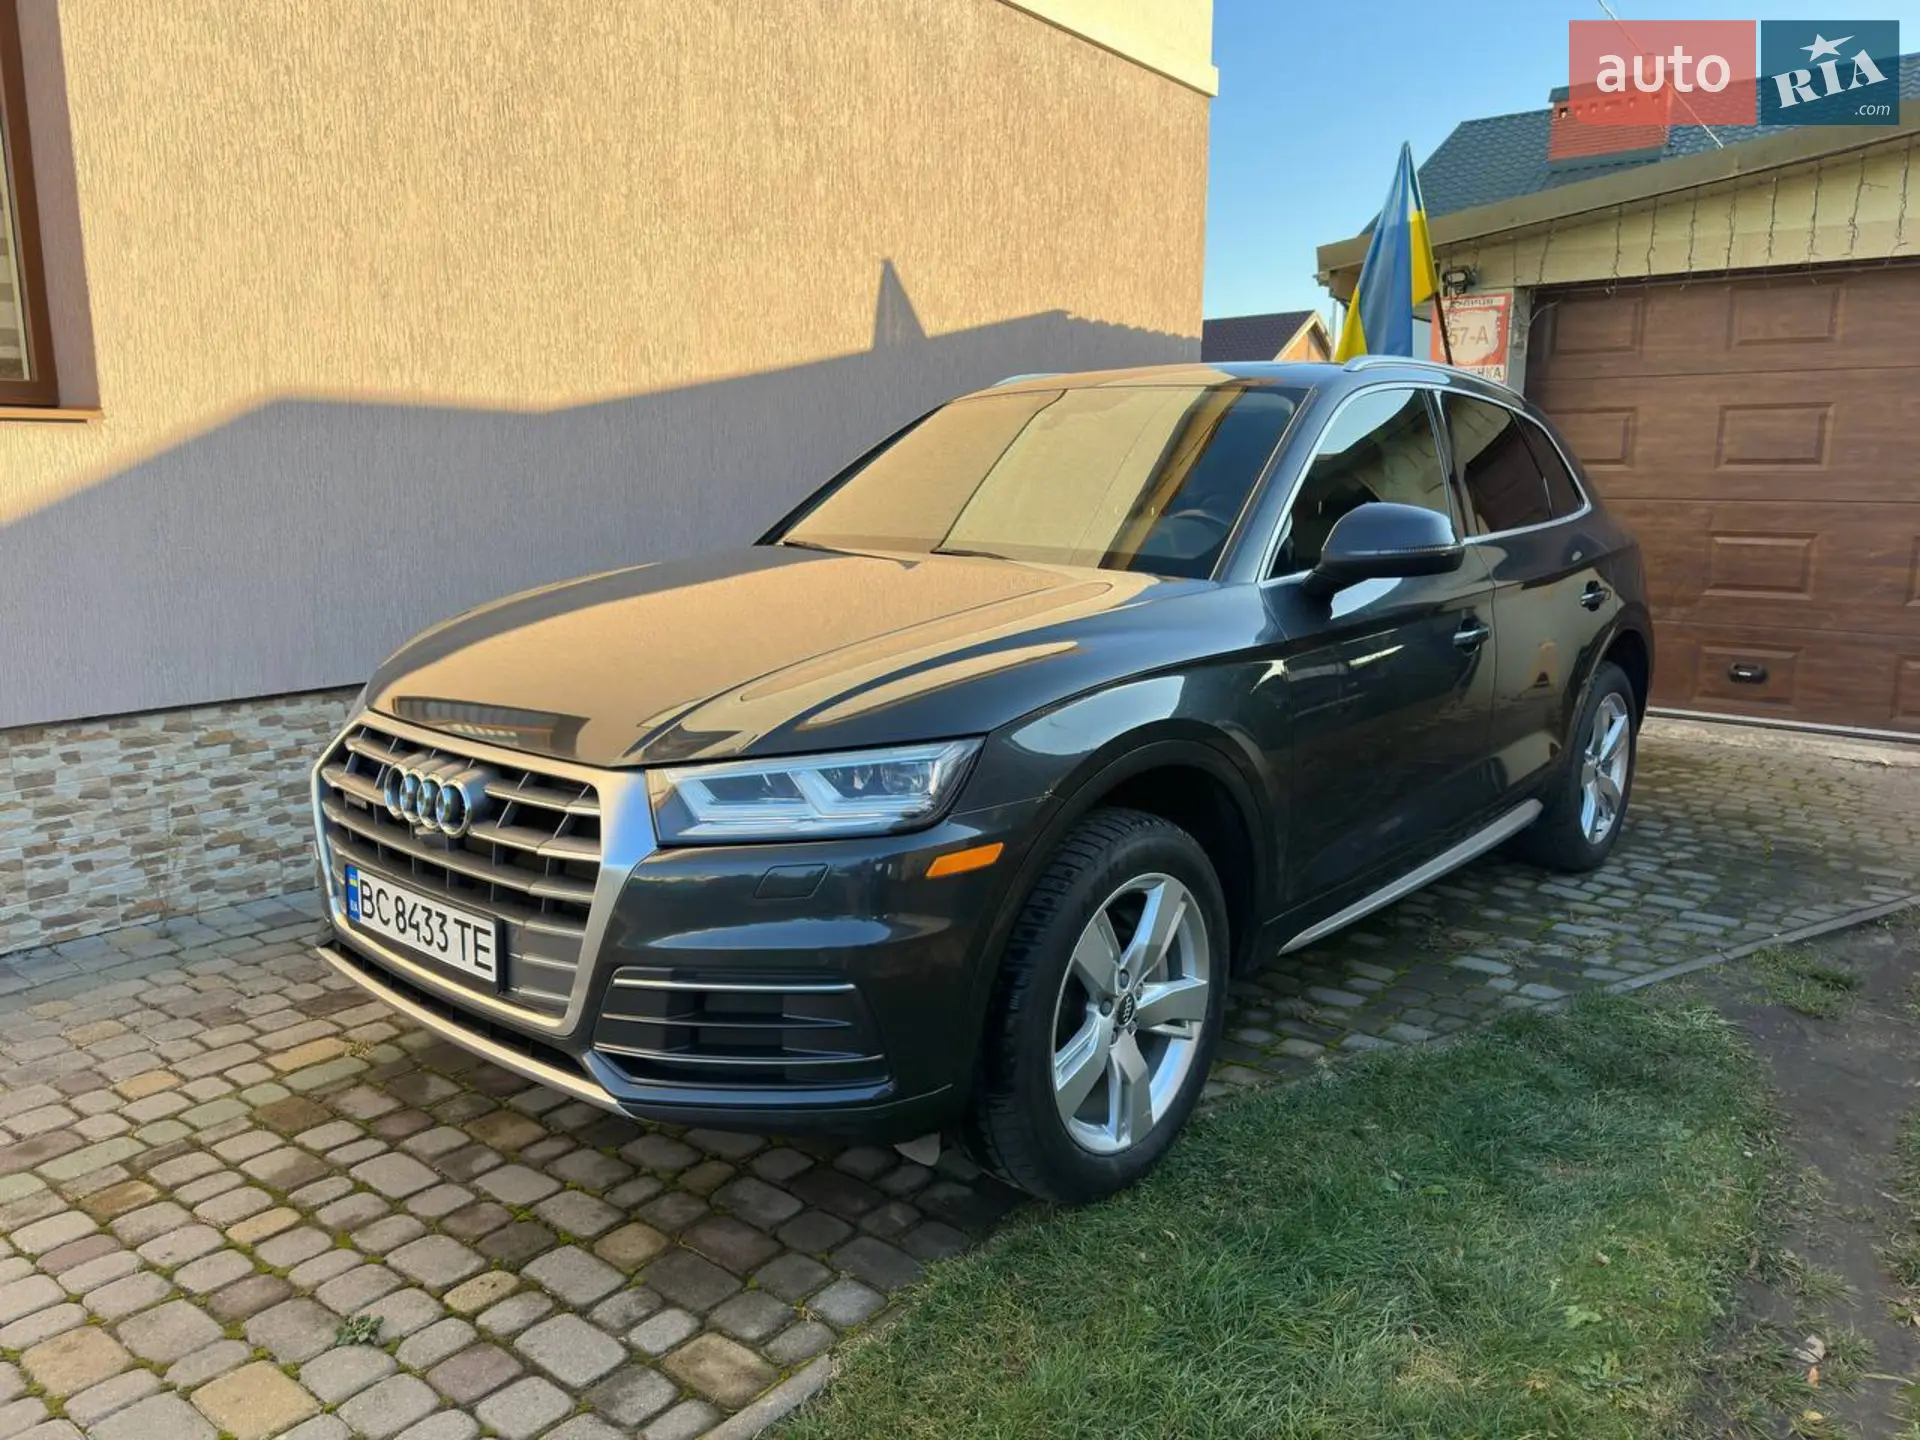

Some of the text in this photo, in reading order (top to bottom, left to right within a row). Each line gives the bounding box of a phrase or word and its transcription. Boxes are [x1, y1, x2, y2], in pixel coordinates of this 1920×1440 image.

[359, 879, 493, 973] BC 8433 TE
